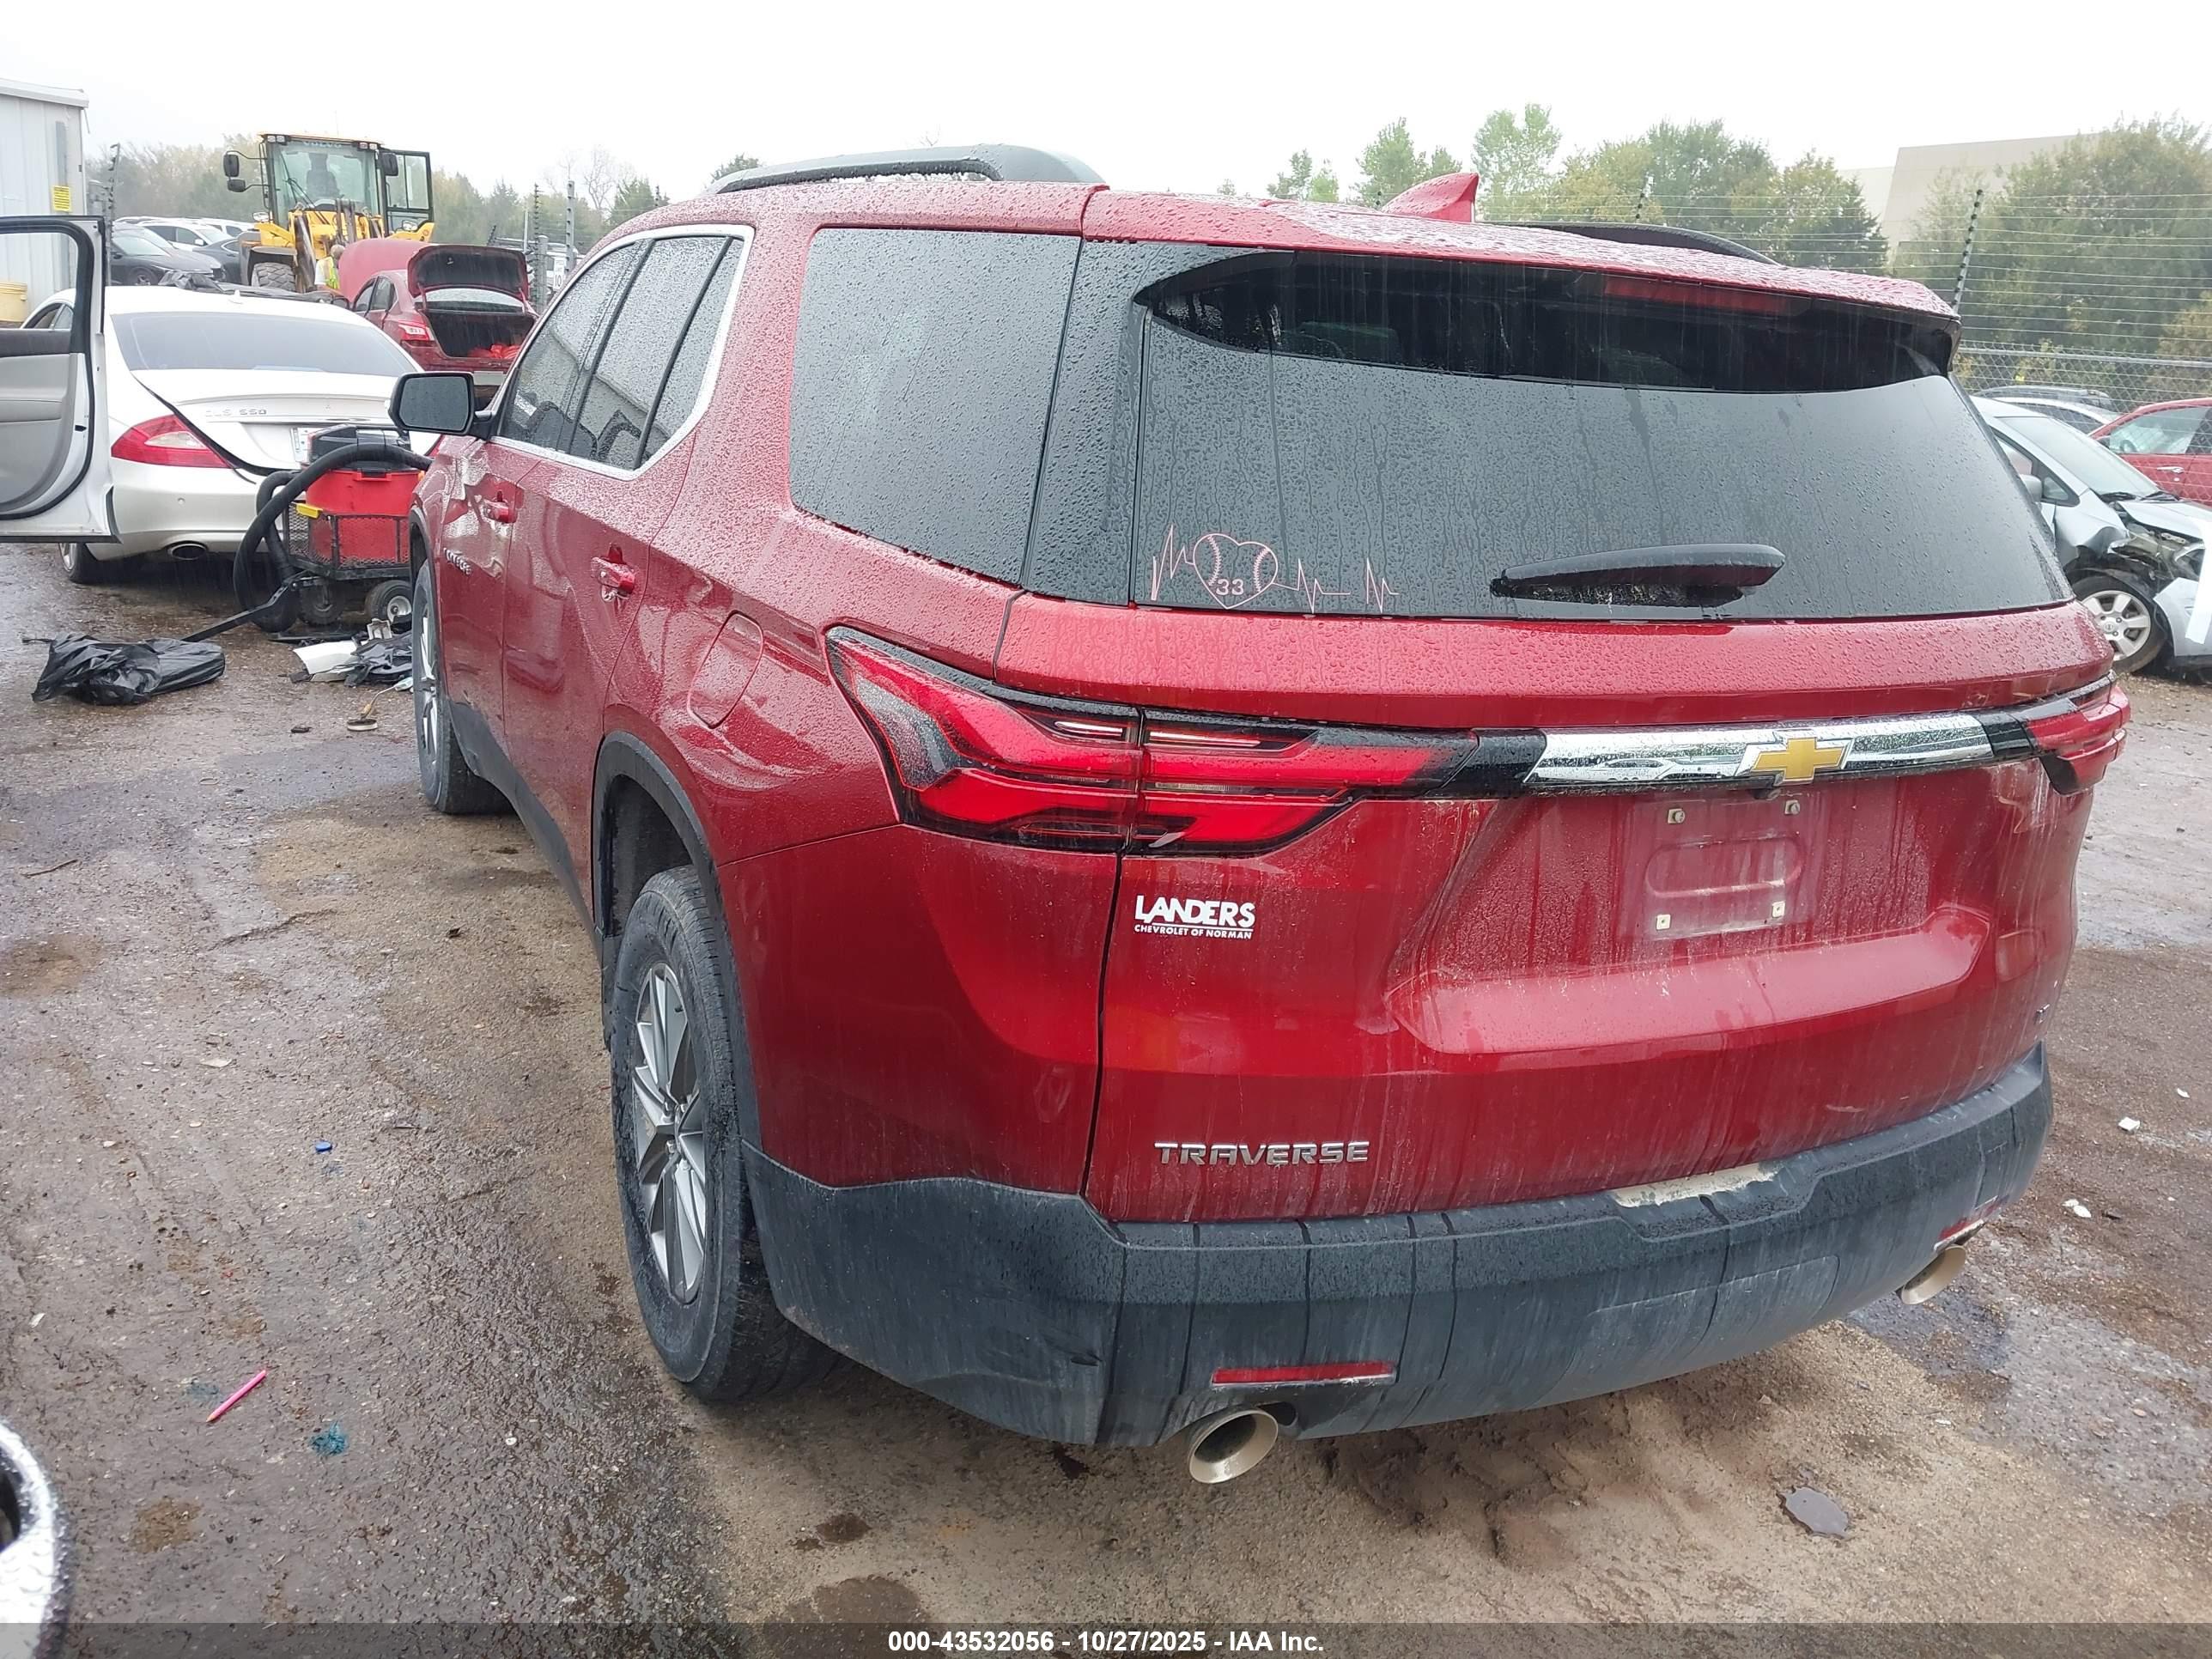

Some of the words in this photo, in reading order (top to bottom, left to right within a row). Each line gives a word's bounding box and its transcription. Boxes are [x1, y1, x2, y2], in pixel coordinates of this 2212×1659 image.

[1216, 579, 1243, 595] 33
[1134, 895, 1255, 928] LANDERS
[1134, 925, 1189, 936] CHEVROLET
[1191, 928, 1204, 937] OF
[1206, 929, 1252, 939] NORMAN
[1154, 1141, 1370, 1164] TRAVERSE
